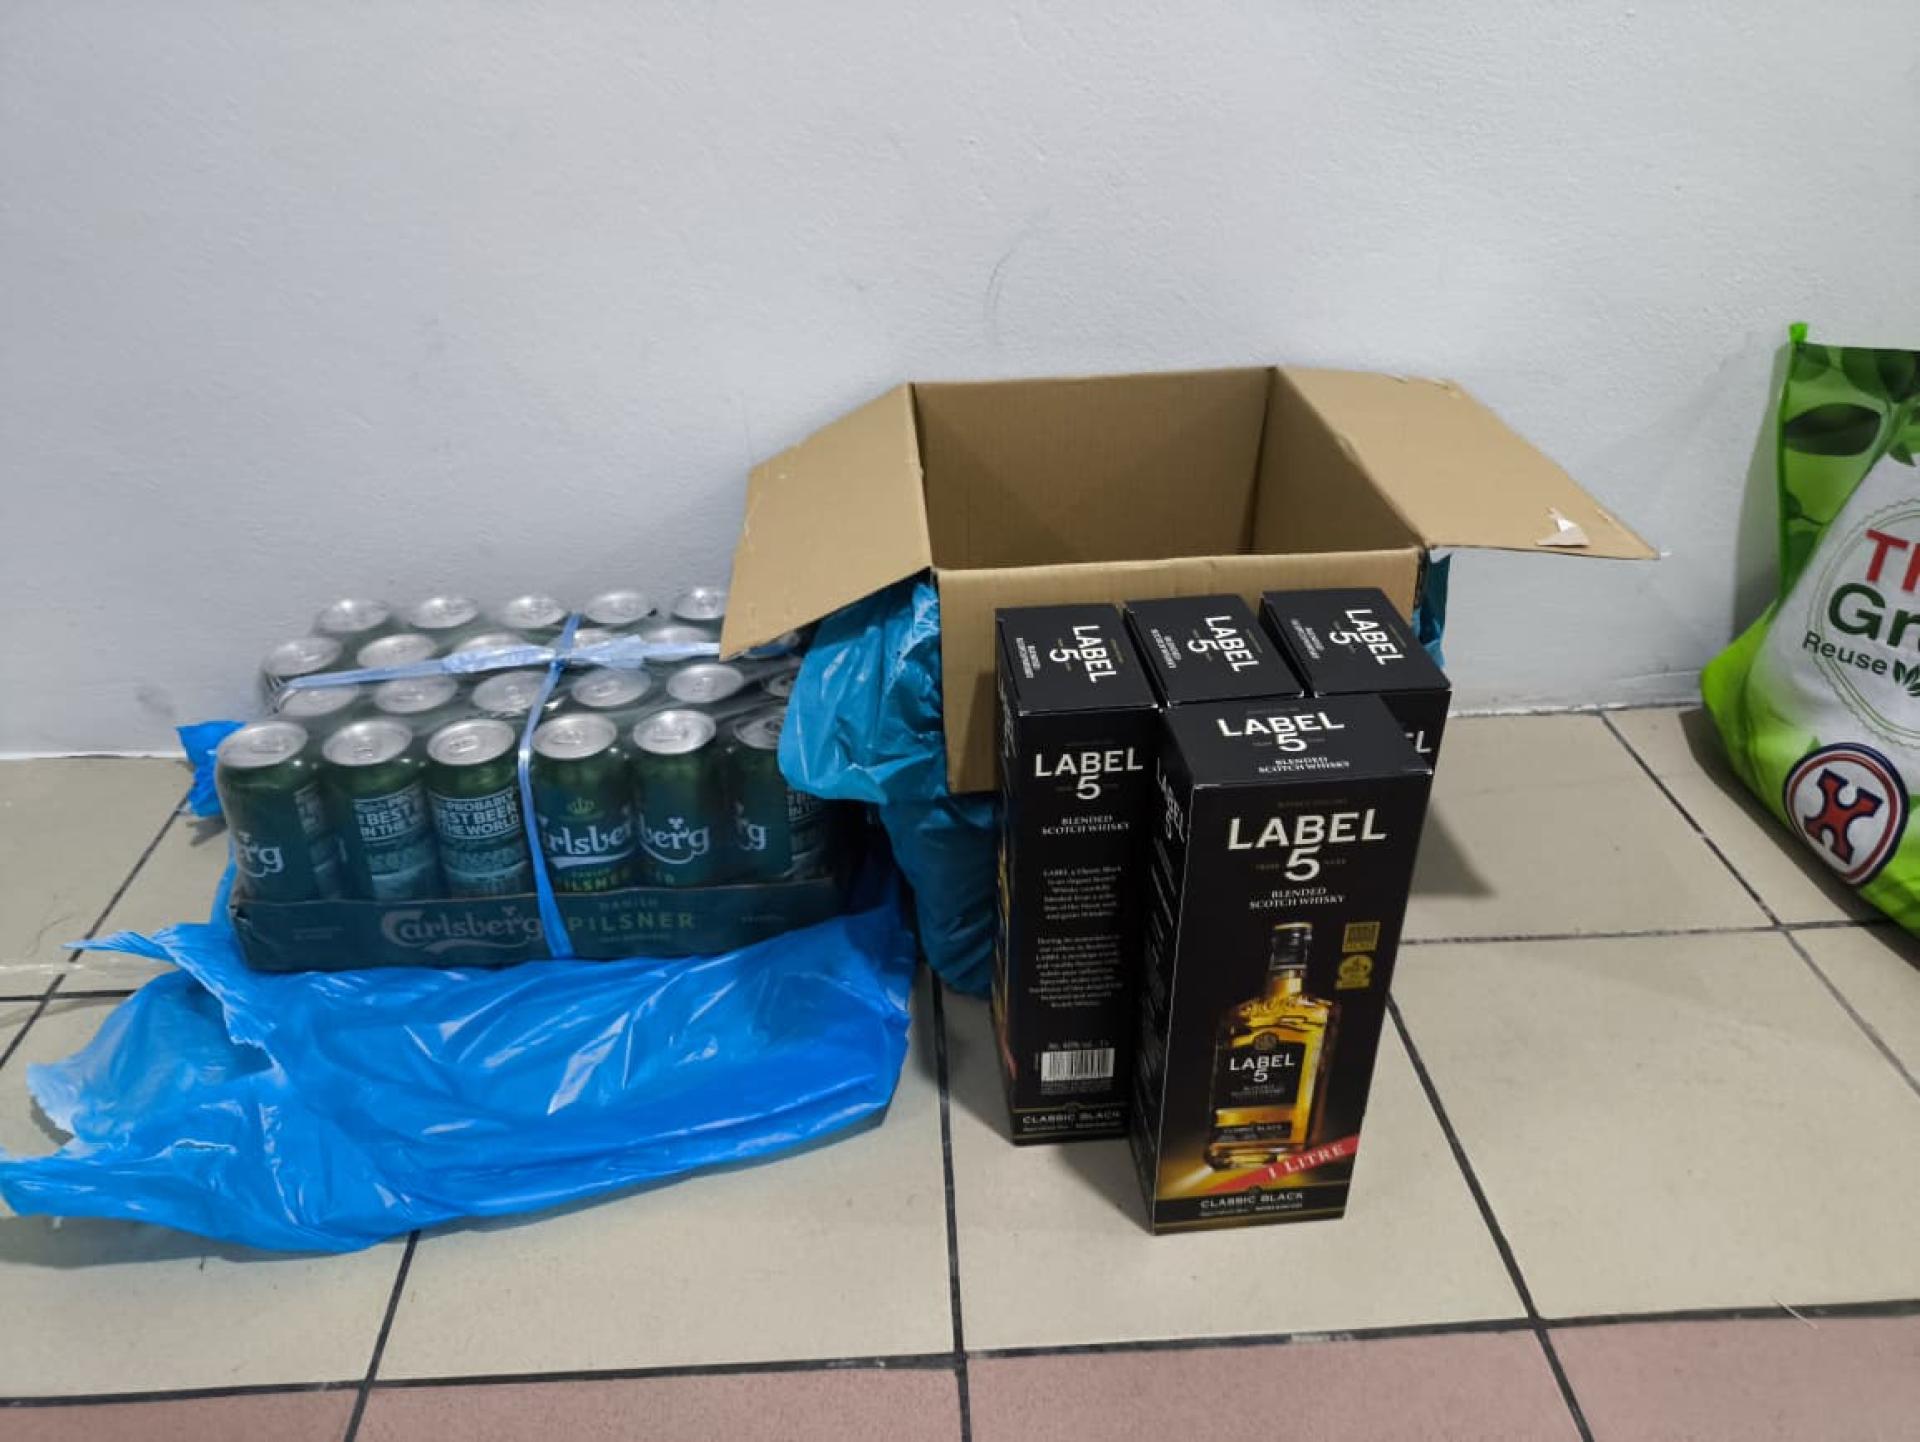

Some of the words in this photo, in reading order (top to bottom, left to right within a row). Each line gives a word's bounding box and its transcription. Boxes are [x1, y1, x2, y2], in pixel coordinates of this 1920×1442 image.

[1829, 583, 1920, 648] Gr
[1187, 637, 1219, 654] 5
[1204, 615, 1259, 672] LABEL
[1329, 630, 1362, 646] 5
[1345, 608, 1405, 666] LABEL
[1049, 647, 1082, 662] 5
[1072, 624, 1117, 684] LABEL
[1802, 630, 1888, 676] Reuse
[1216, 712, 1345, 737] LABEL
[1277, 732, 1308, 752] 5
[1035, 746, 1144, 777] LABEL
[1076, 774, 1101, 800] 5
[1228, 808, 1387, 850] LABEL
[1284, 845, 1321, 882] 5
[1249, 898, 1298, 910] SCOTCH
[1300, 894, 1345, 906] WHISKY
[1271, 887, 1327, 899] BLENDED
[382, 905, 545, 948] Carlsberg
[566, 911, 696, 932] PILSNER
[1229, 1052, 1295, 1071] LABEL
[1253, 1069, 1268, 1082] 5
[1284, 1143, 1345, 1174] LITRE
[1200, 1195, 1257, 1209] CLASSIC
[1260, 1192, 1304, 1203] BLACK
